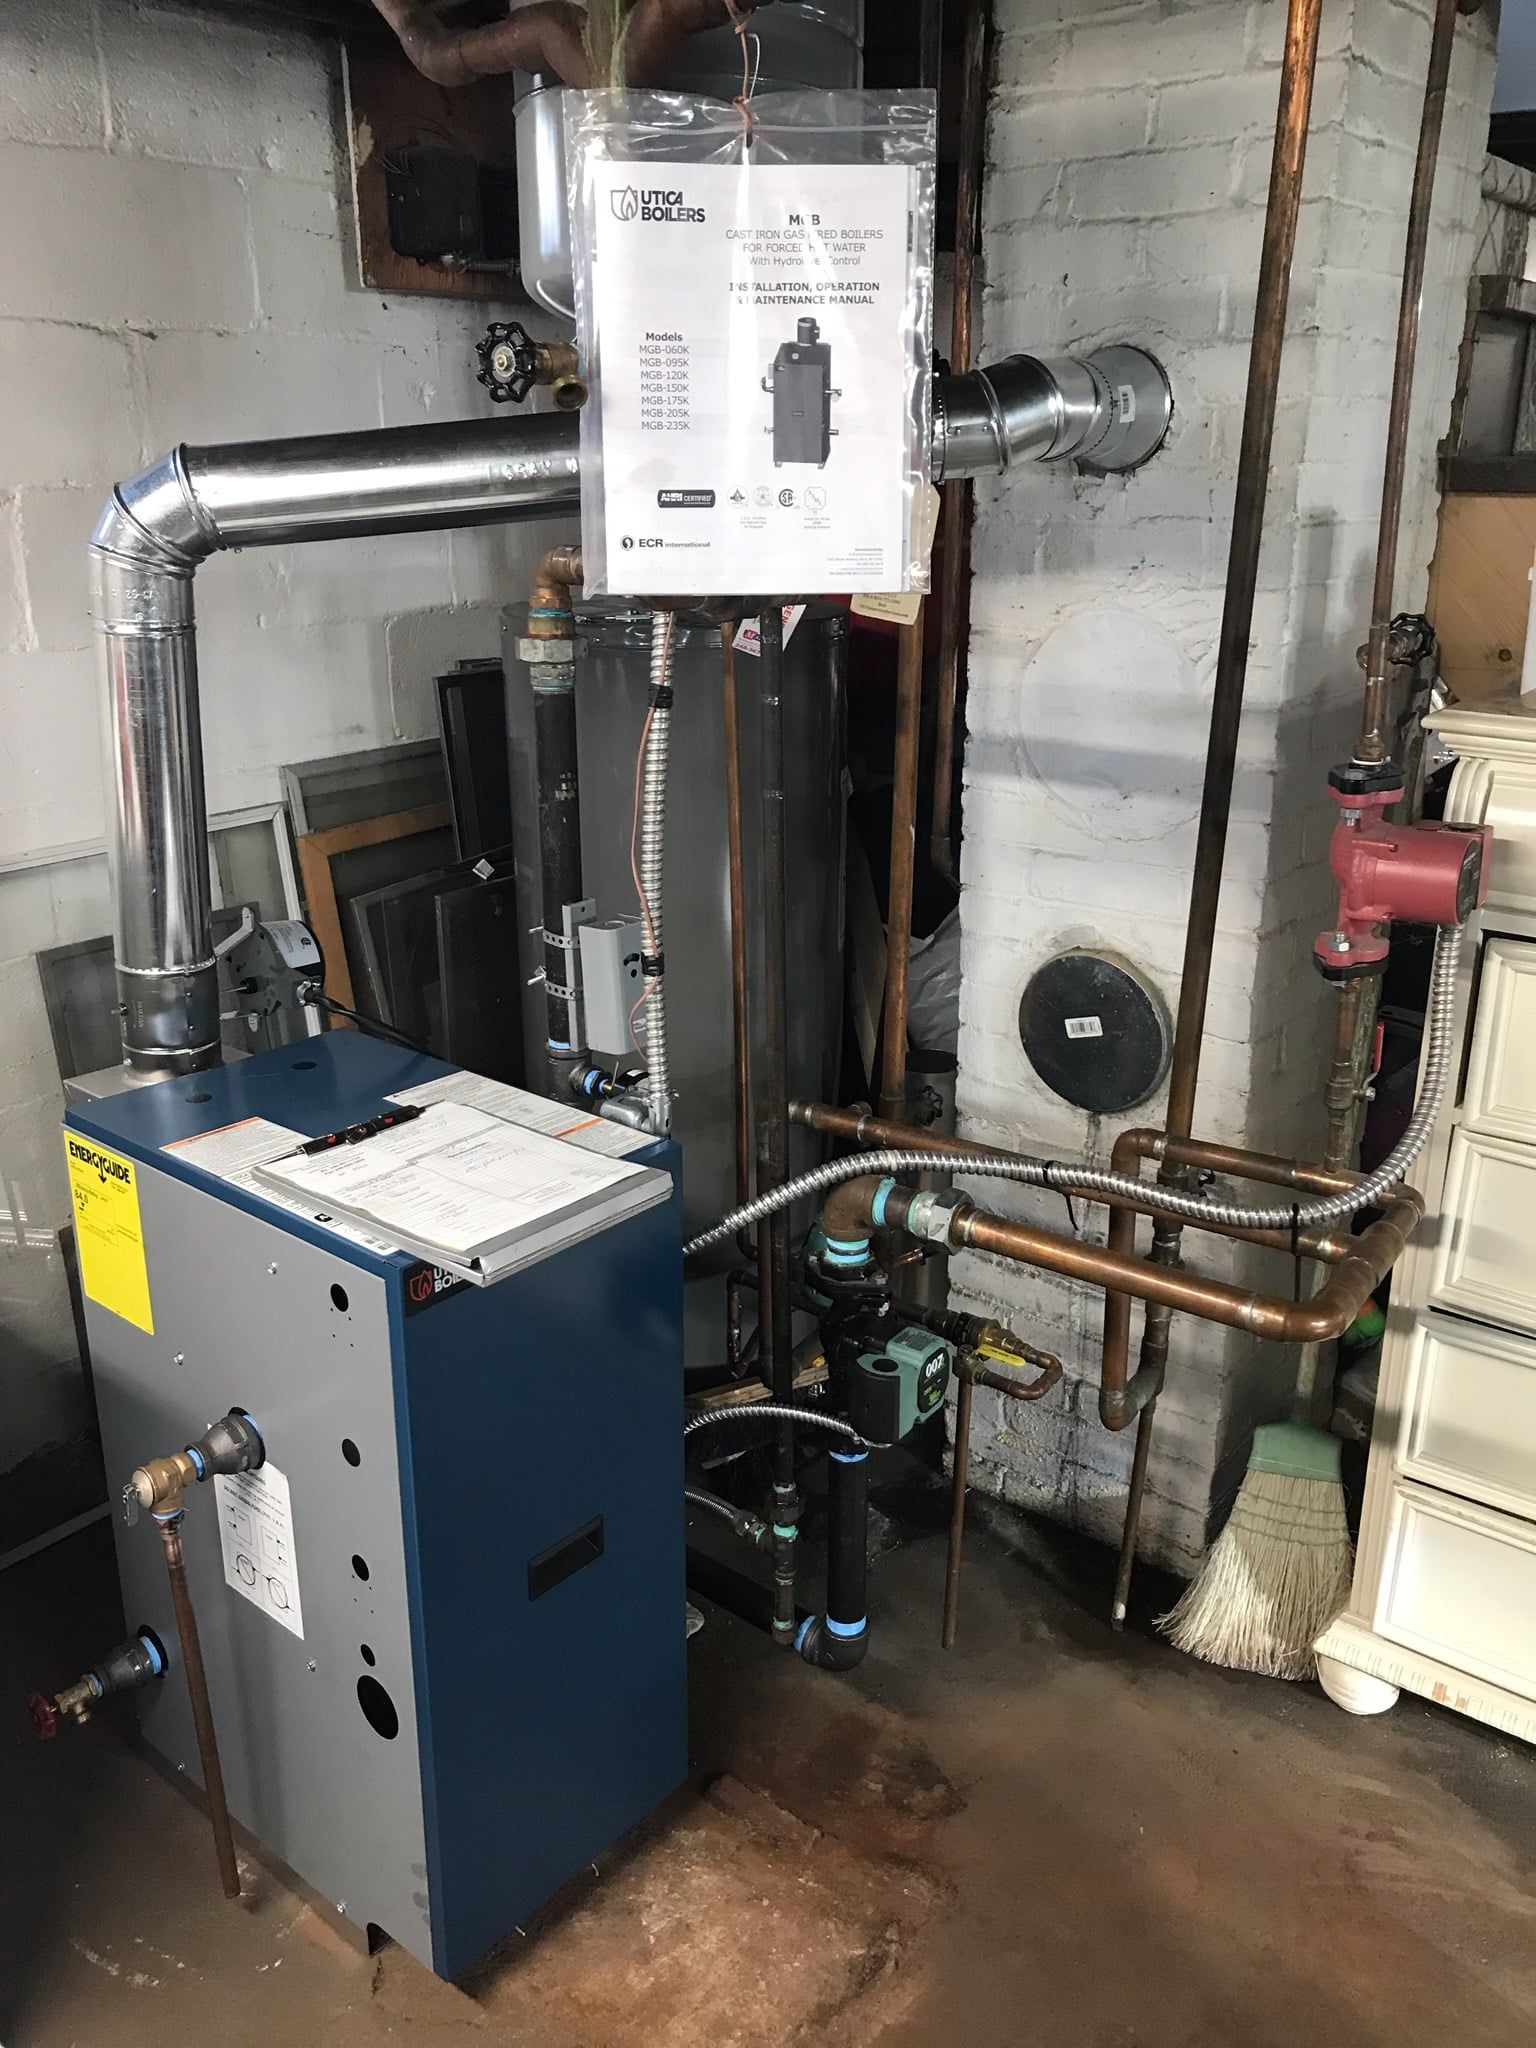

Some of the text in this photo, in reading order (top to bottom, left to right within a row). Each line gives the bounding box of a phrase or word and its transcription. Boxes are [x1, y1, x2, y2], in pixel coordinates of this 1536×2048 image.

[641, 190, 683, 206] UTICA
[641, 206, 706, 223] BOILERS
[726, 229, 884, 240] CAST IRON GAS RED BOILERS
[743, 243, 762, 253] FOR
[809, 243, 830, 253] HT
[833, 242, 866, 253] WATER
[750, 256, 770, 266] With
[729, 282, 880, 293] INSTALLATION, OPERATION
[829, 295, 875, 305] MANUAL
[645, 332, 684, 342] Models
[639, 344, 690, 354] MGB-060K
[640, 357, 690, 367] MGB-095K
[640, 370, 690, 380] MGB-120K
[640, 383, 690, 393] MGB-150K
[641, 395, 690, 406] MGB-175K
[641, 408, 690, 418] MGB-205K
[641, 421, 690, 431] MGB-235K
[639, 538, 663, 548] ECR
[69, 1140, 131, 1185] ENERGYGUIDE
